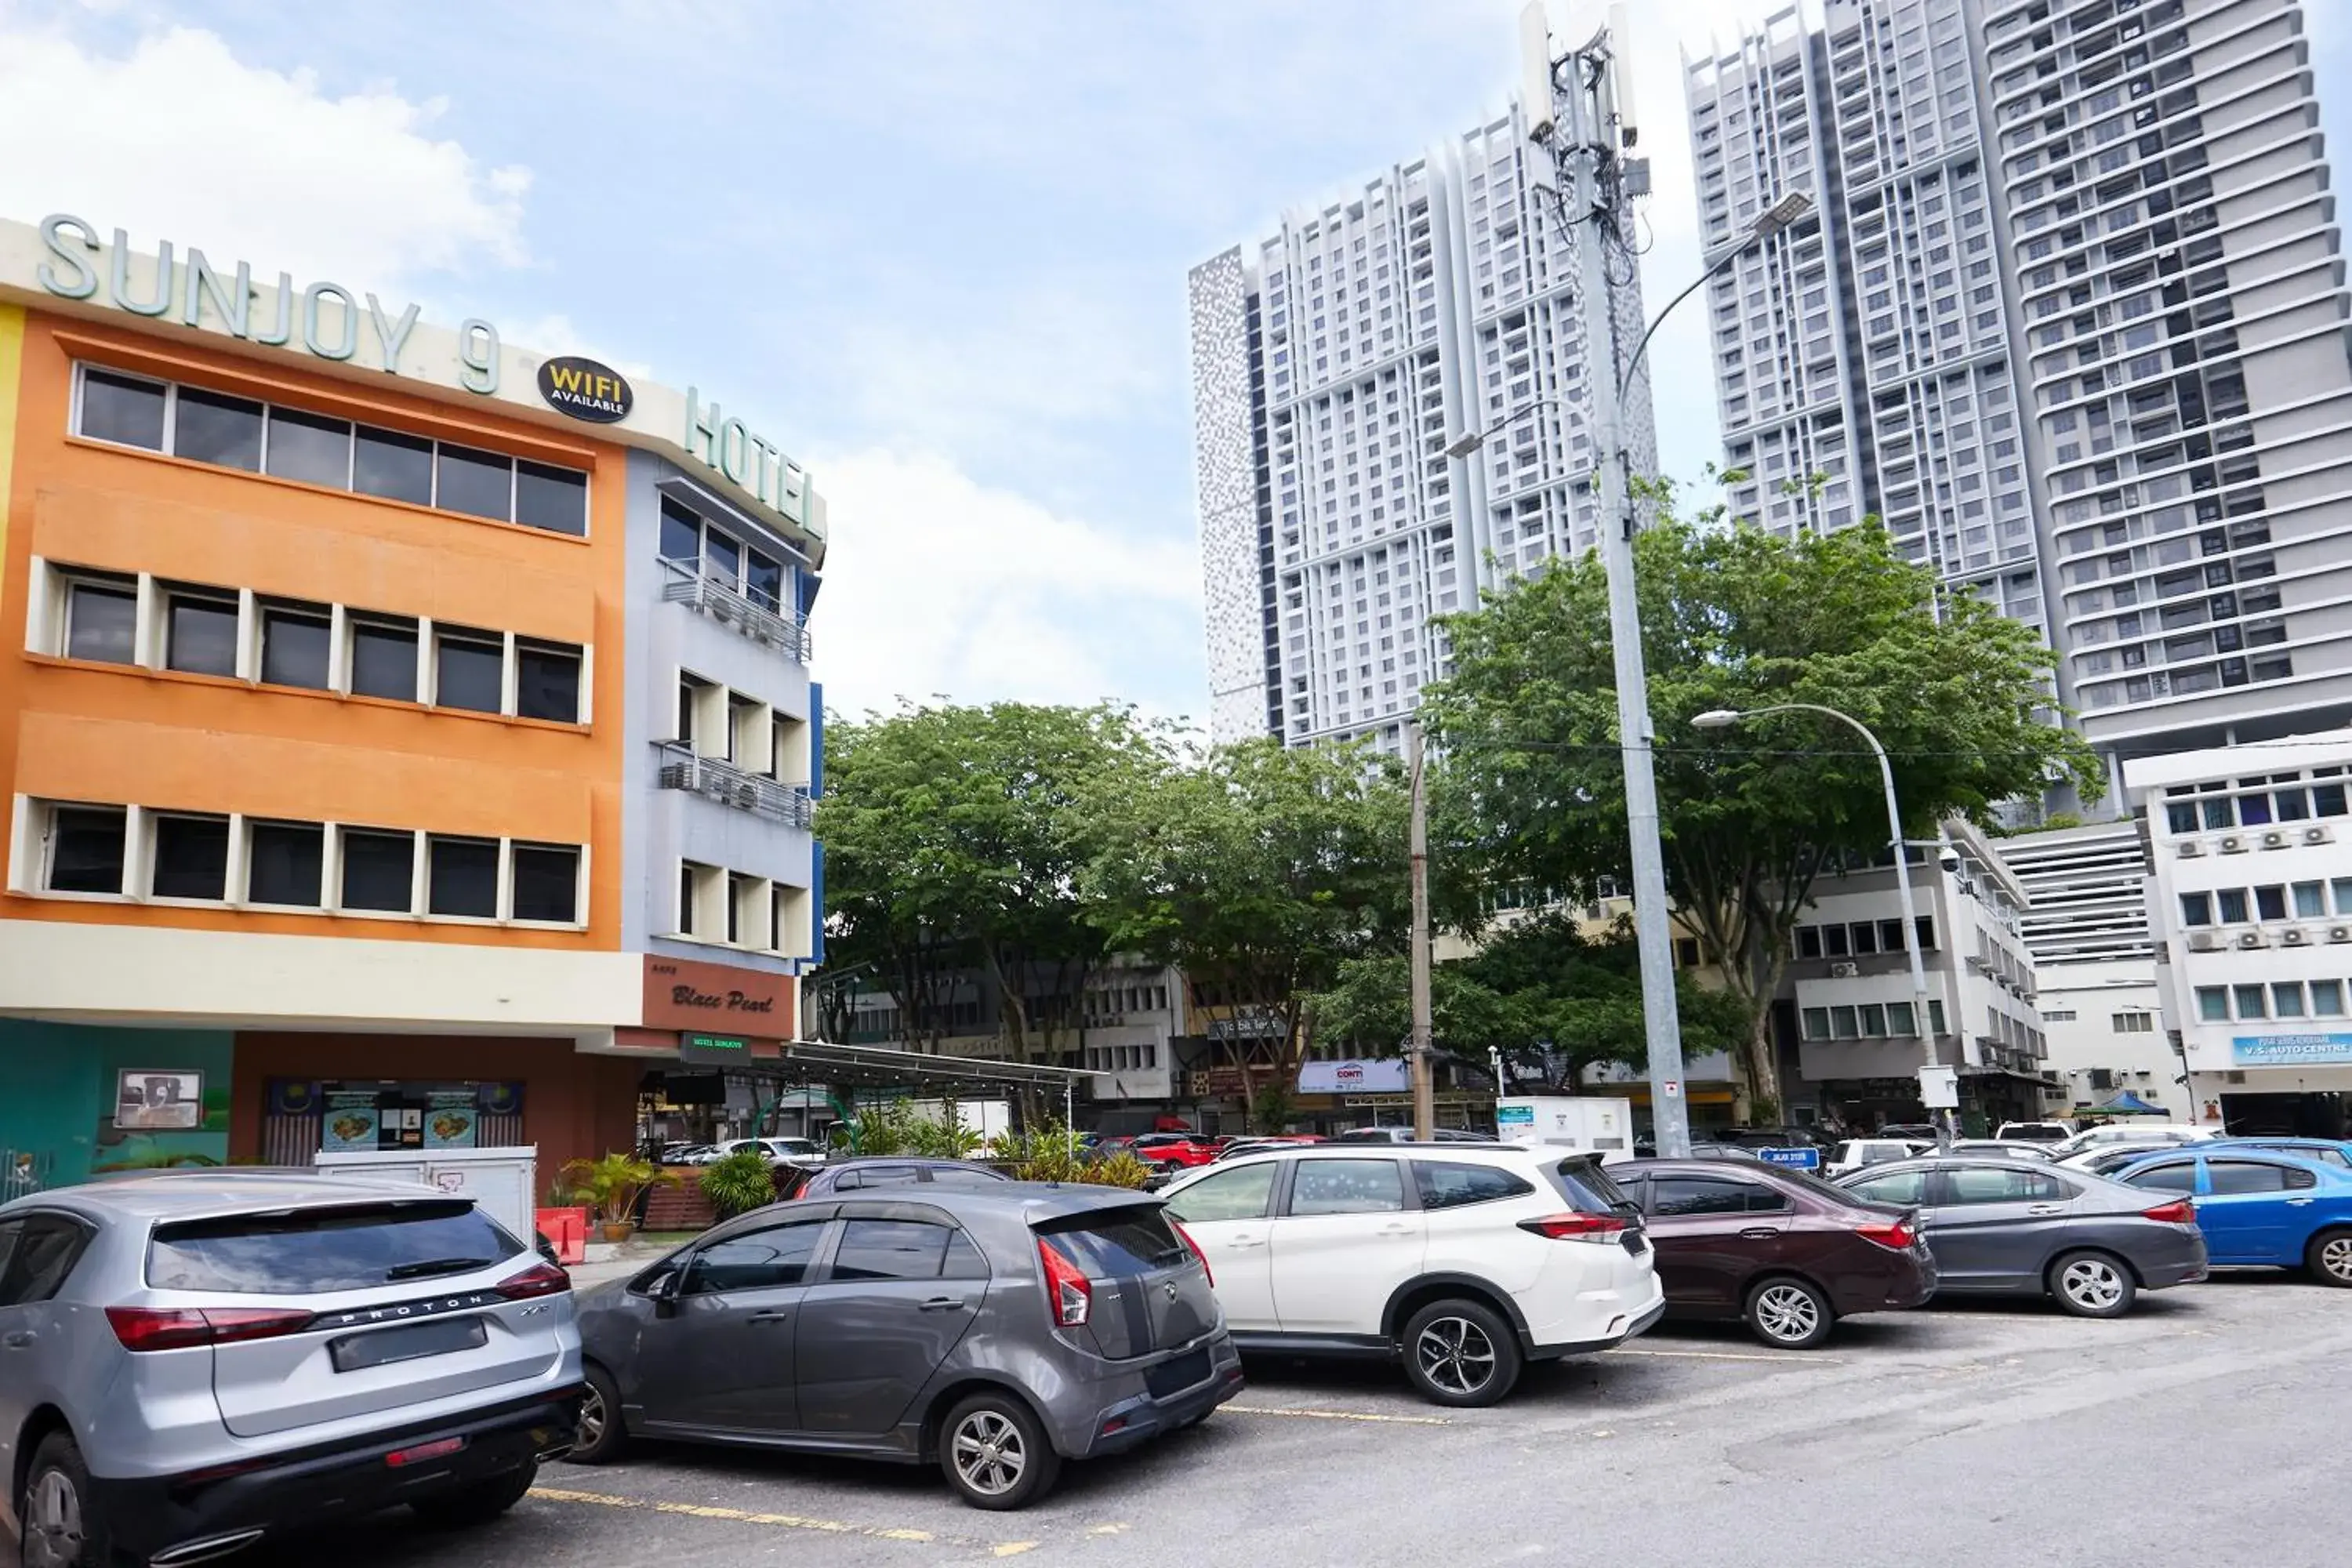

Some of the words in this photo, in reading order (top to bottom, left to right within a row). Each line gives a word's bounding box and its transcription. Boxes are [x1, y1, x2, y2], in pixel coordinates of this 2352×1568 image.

[38, 214, 421, 373] SUNJOY
[460, 318, 501, 394] 9
[550, 365, 621, 402] WIFI
[551, 390, 624, 415] AVAILABLE
[685, 385, 826, 541] HOTEL
[341, 1295, 482, 1323] PROTON
